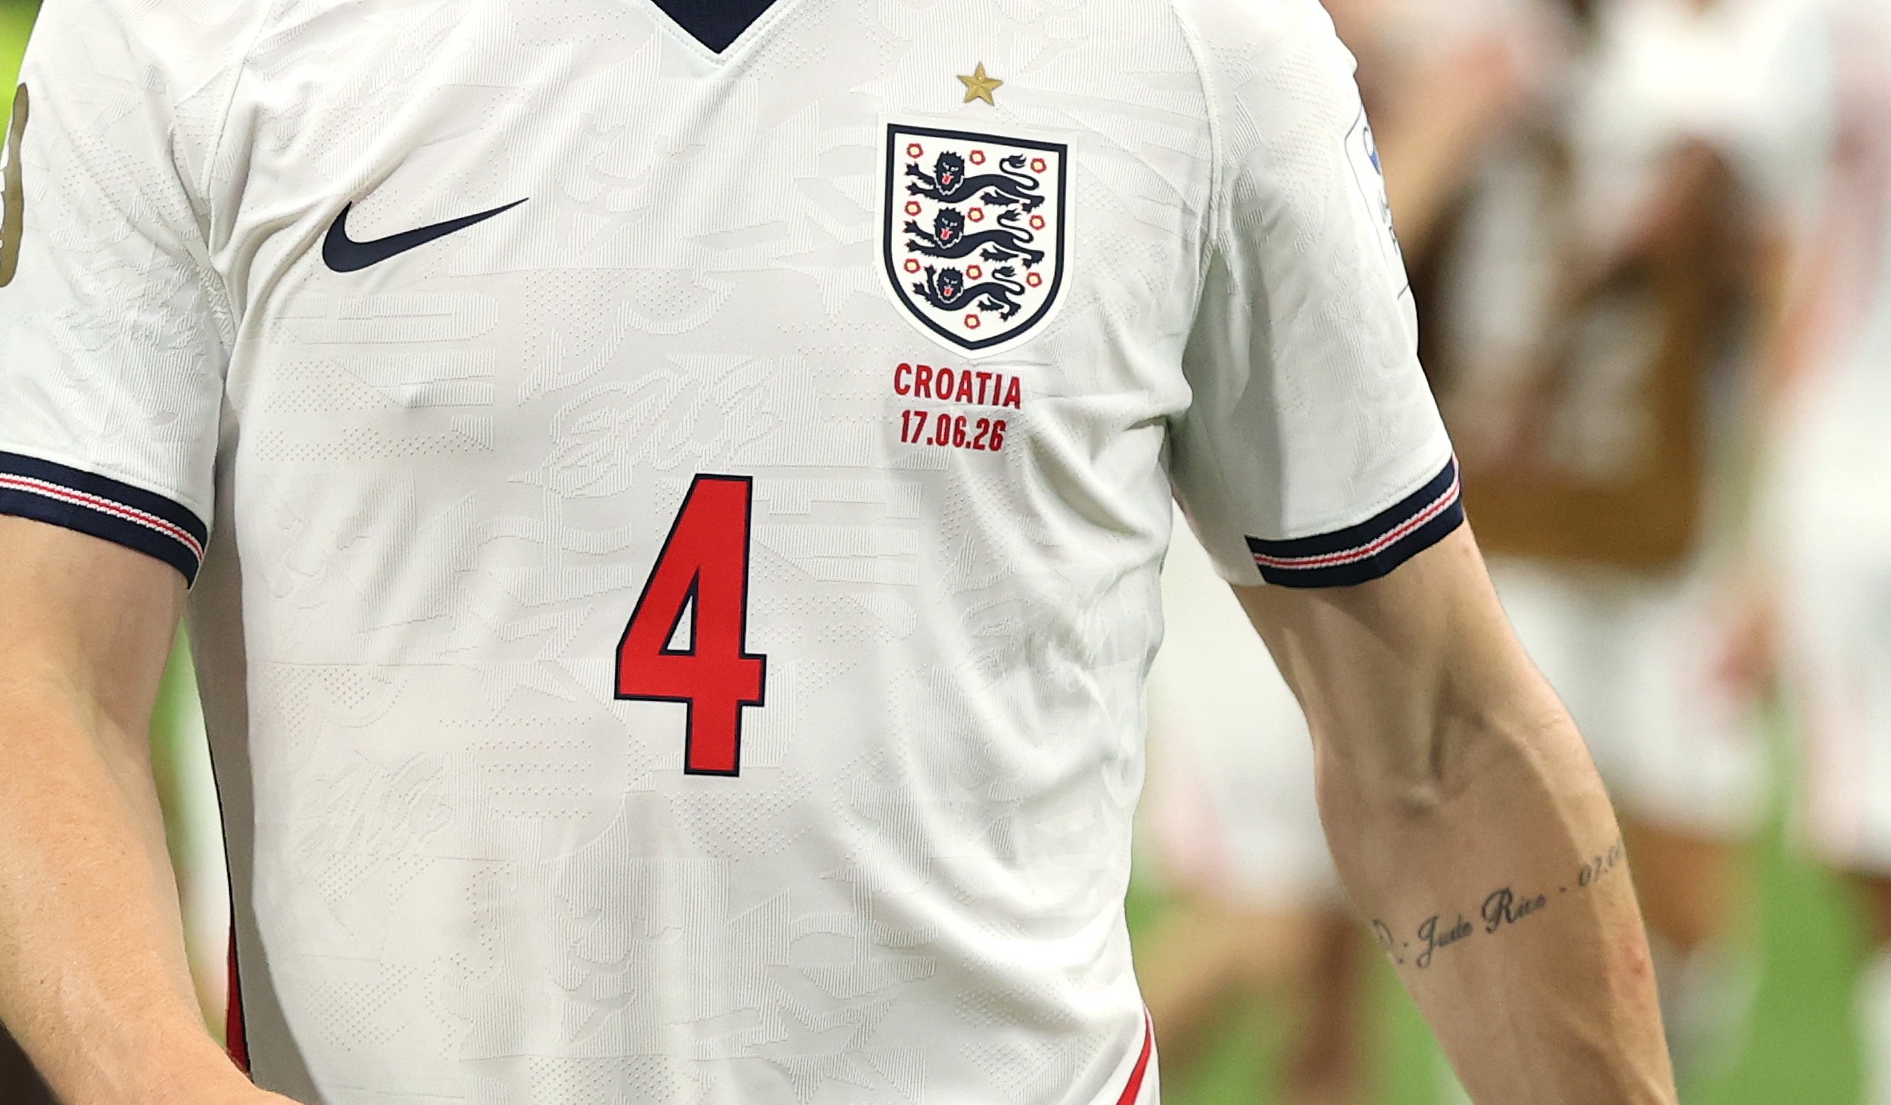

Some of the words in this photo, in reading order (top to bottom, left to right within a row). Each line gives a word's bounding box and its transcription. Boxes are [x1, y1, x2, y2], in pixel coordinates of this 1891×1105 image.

[893, 362, 1022, 410] CROATIA
[900, 409, 1008, 452] 17.06.26
[614, 473, 767, 778] 4
